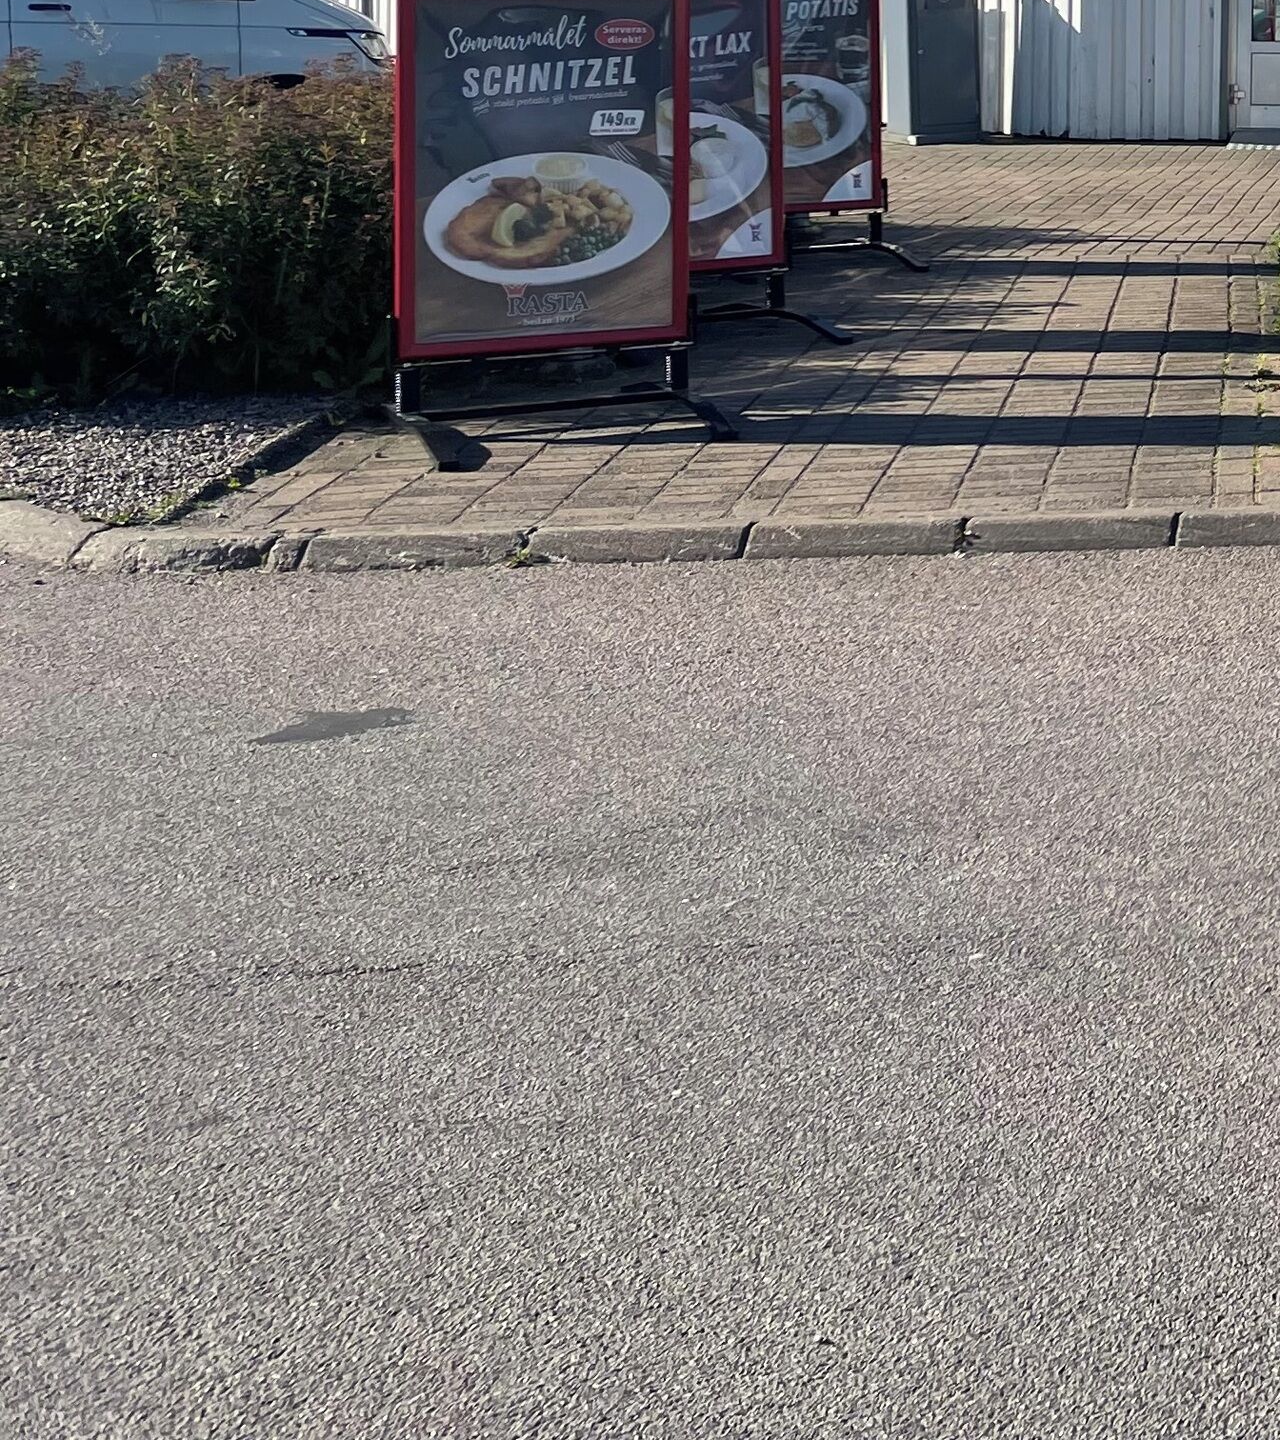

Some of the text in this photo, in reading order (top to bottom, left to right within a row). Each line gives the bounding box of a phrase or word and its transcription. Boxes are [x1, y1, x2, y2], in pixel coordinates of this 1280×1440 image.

[445, 15, 587, 59] Sommarmålet
[602, 25, 647, 35] Serveras
[607, 34, 642, 44] direkt!
[715, 31, 752, 56] LAX
[462, 55, 637, 98] SCHNITZEL
[507, 291, 589, 316] RASTA
